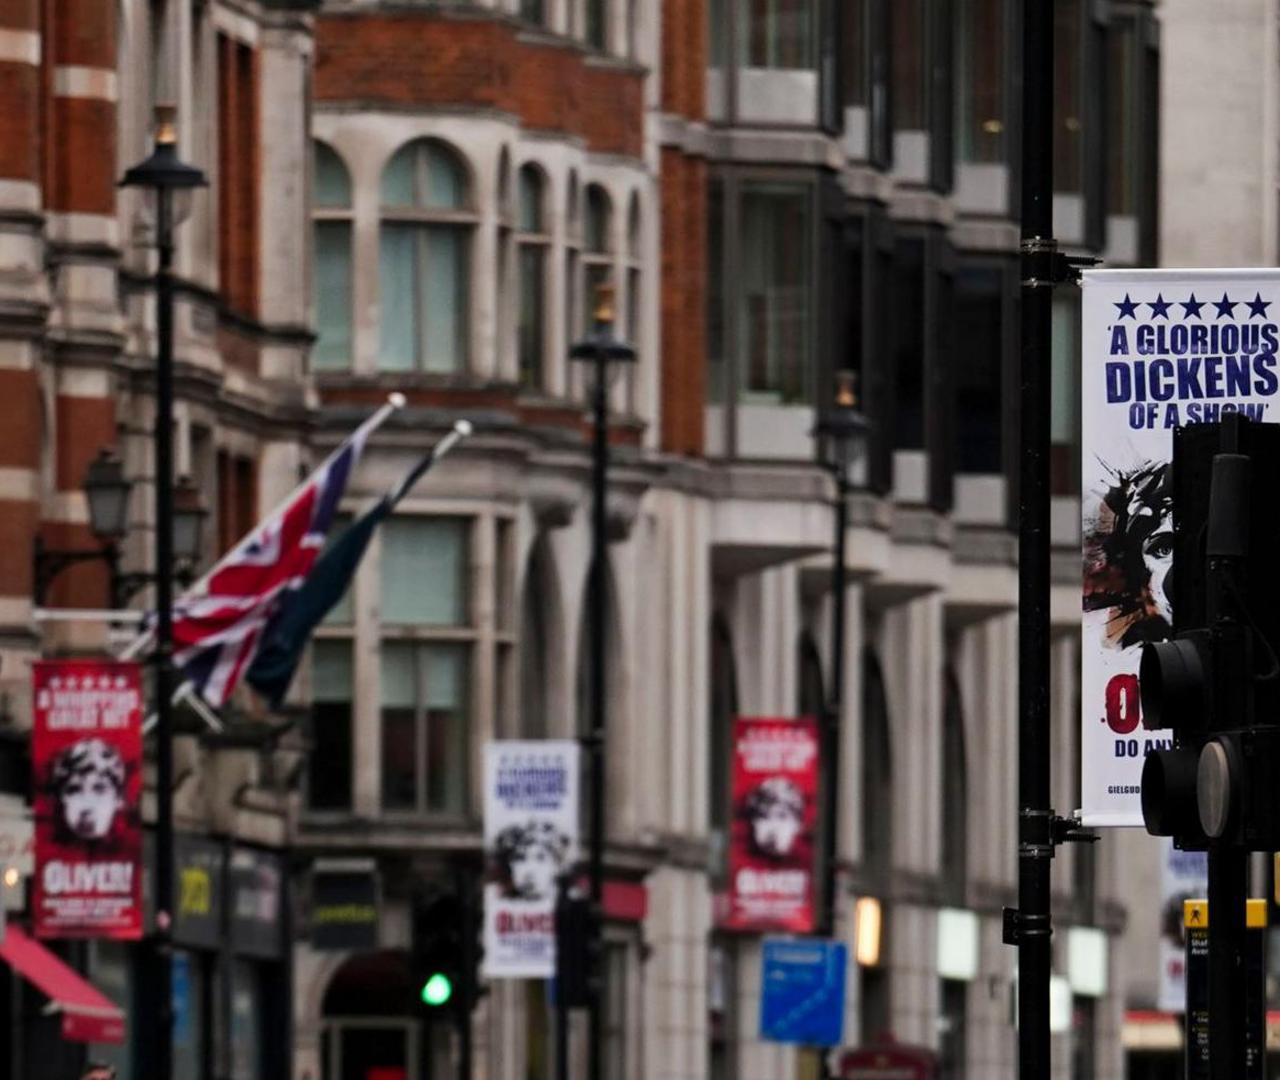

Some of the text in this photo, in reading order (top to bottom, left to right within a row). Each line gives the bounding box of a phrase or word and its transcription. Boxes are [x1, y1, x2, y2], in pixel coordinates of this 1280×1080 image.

[1136, 323, 1279, 356] GLORIOUS
[1105, 353, 1279, 404] DICKENS
[1129, 403, 1159, 429] OF
[1164, 403, 1180, 429] A
[1115, 739, 1139, 758] DO
